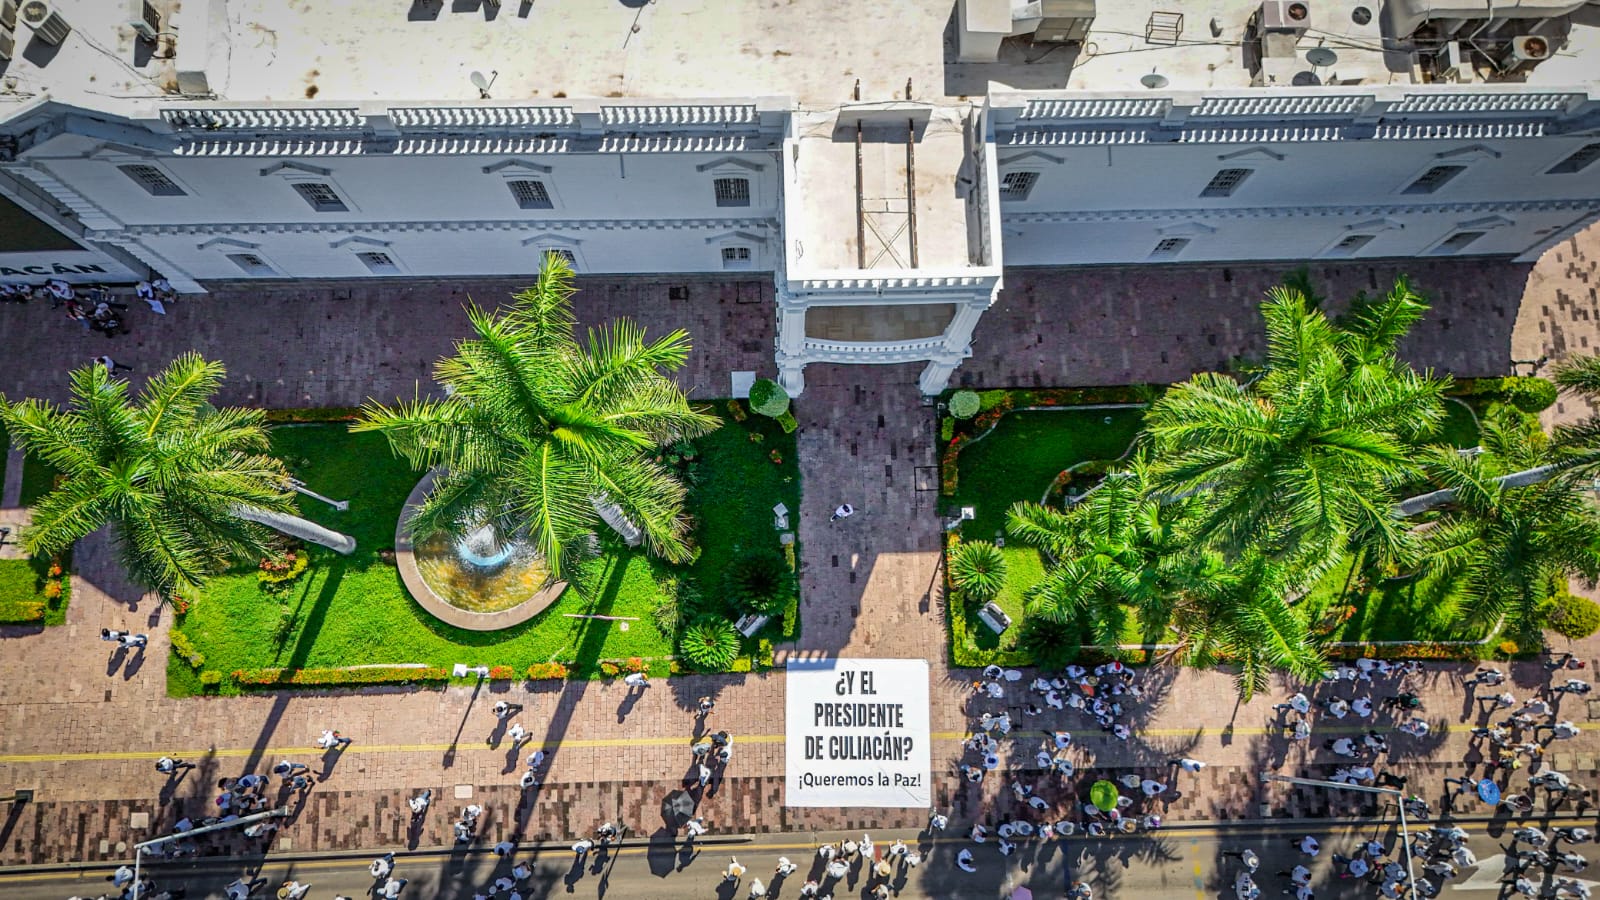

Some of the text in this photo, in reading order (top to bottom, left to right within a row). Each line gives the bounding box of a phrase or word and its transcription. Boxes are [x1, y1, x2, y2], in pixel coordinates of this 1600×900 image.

[835, 670, 877, 696] ¿Y EL
[814, 703, 904, 728] PRESIDENTE
[805, 731, 913, 761] DE CULIACÁN?
[798, 771, 921, 790] ¡Queremos la Paz!
